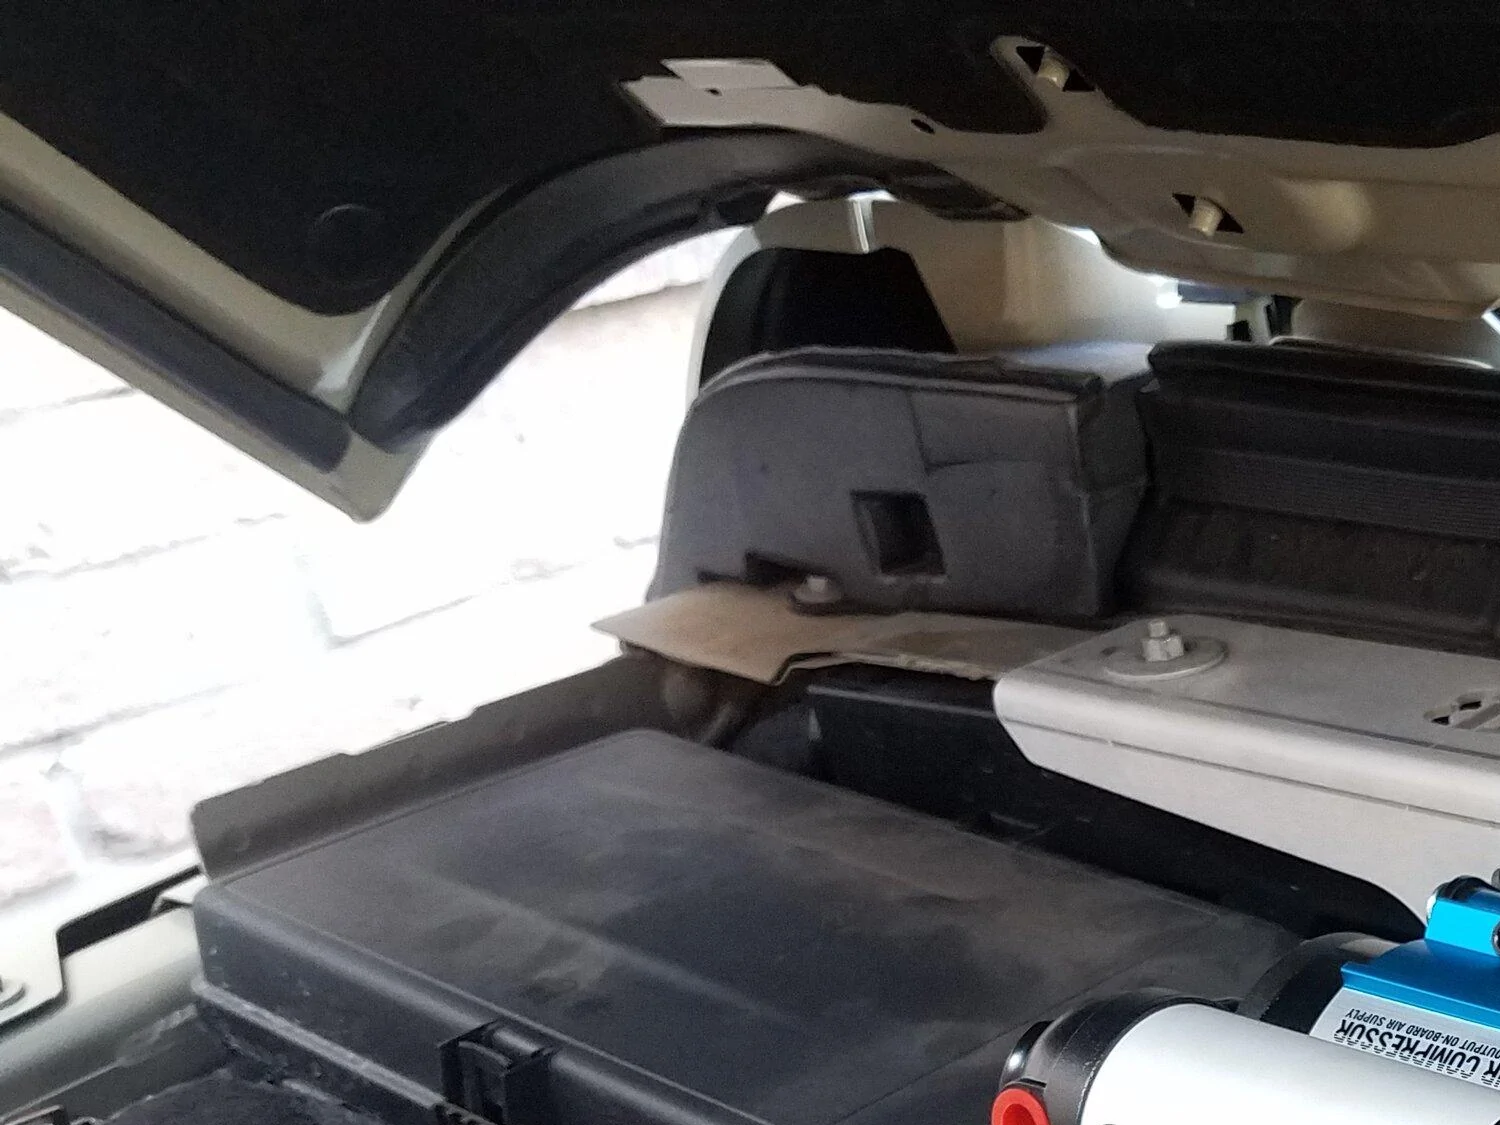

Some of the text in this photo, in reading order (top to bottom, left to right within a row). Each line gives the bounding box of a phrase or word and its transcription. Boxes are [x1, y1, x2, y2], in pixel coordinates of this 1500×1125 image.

[1345, 1008, 1386, 1027] SUPPLY
[1386, 1019, 1406, 1032] AIR
[1406, 1024, 1460, 1046] ON-BOARD
[1333, 1019, 1481, 1079] COMPRESSOR
